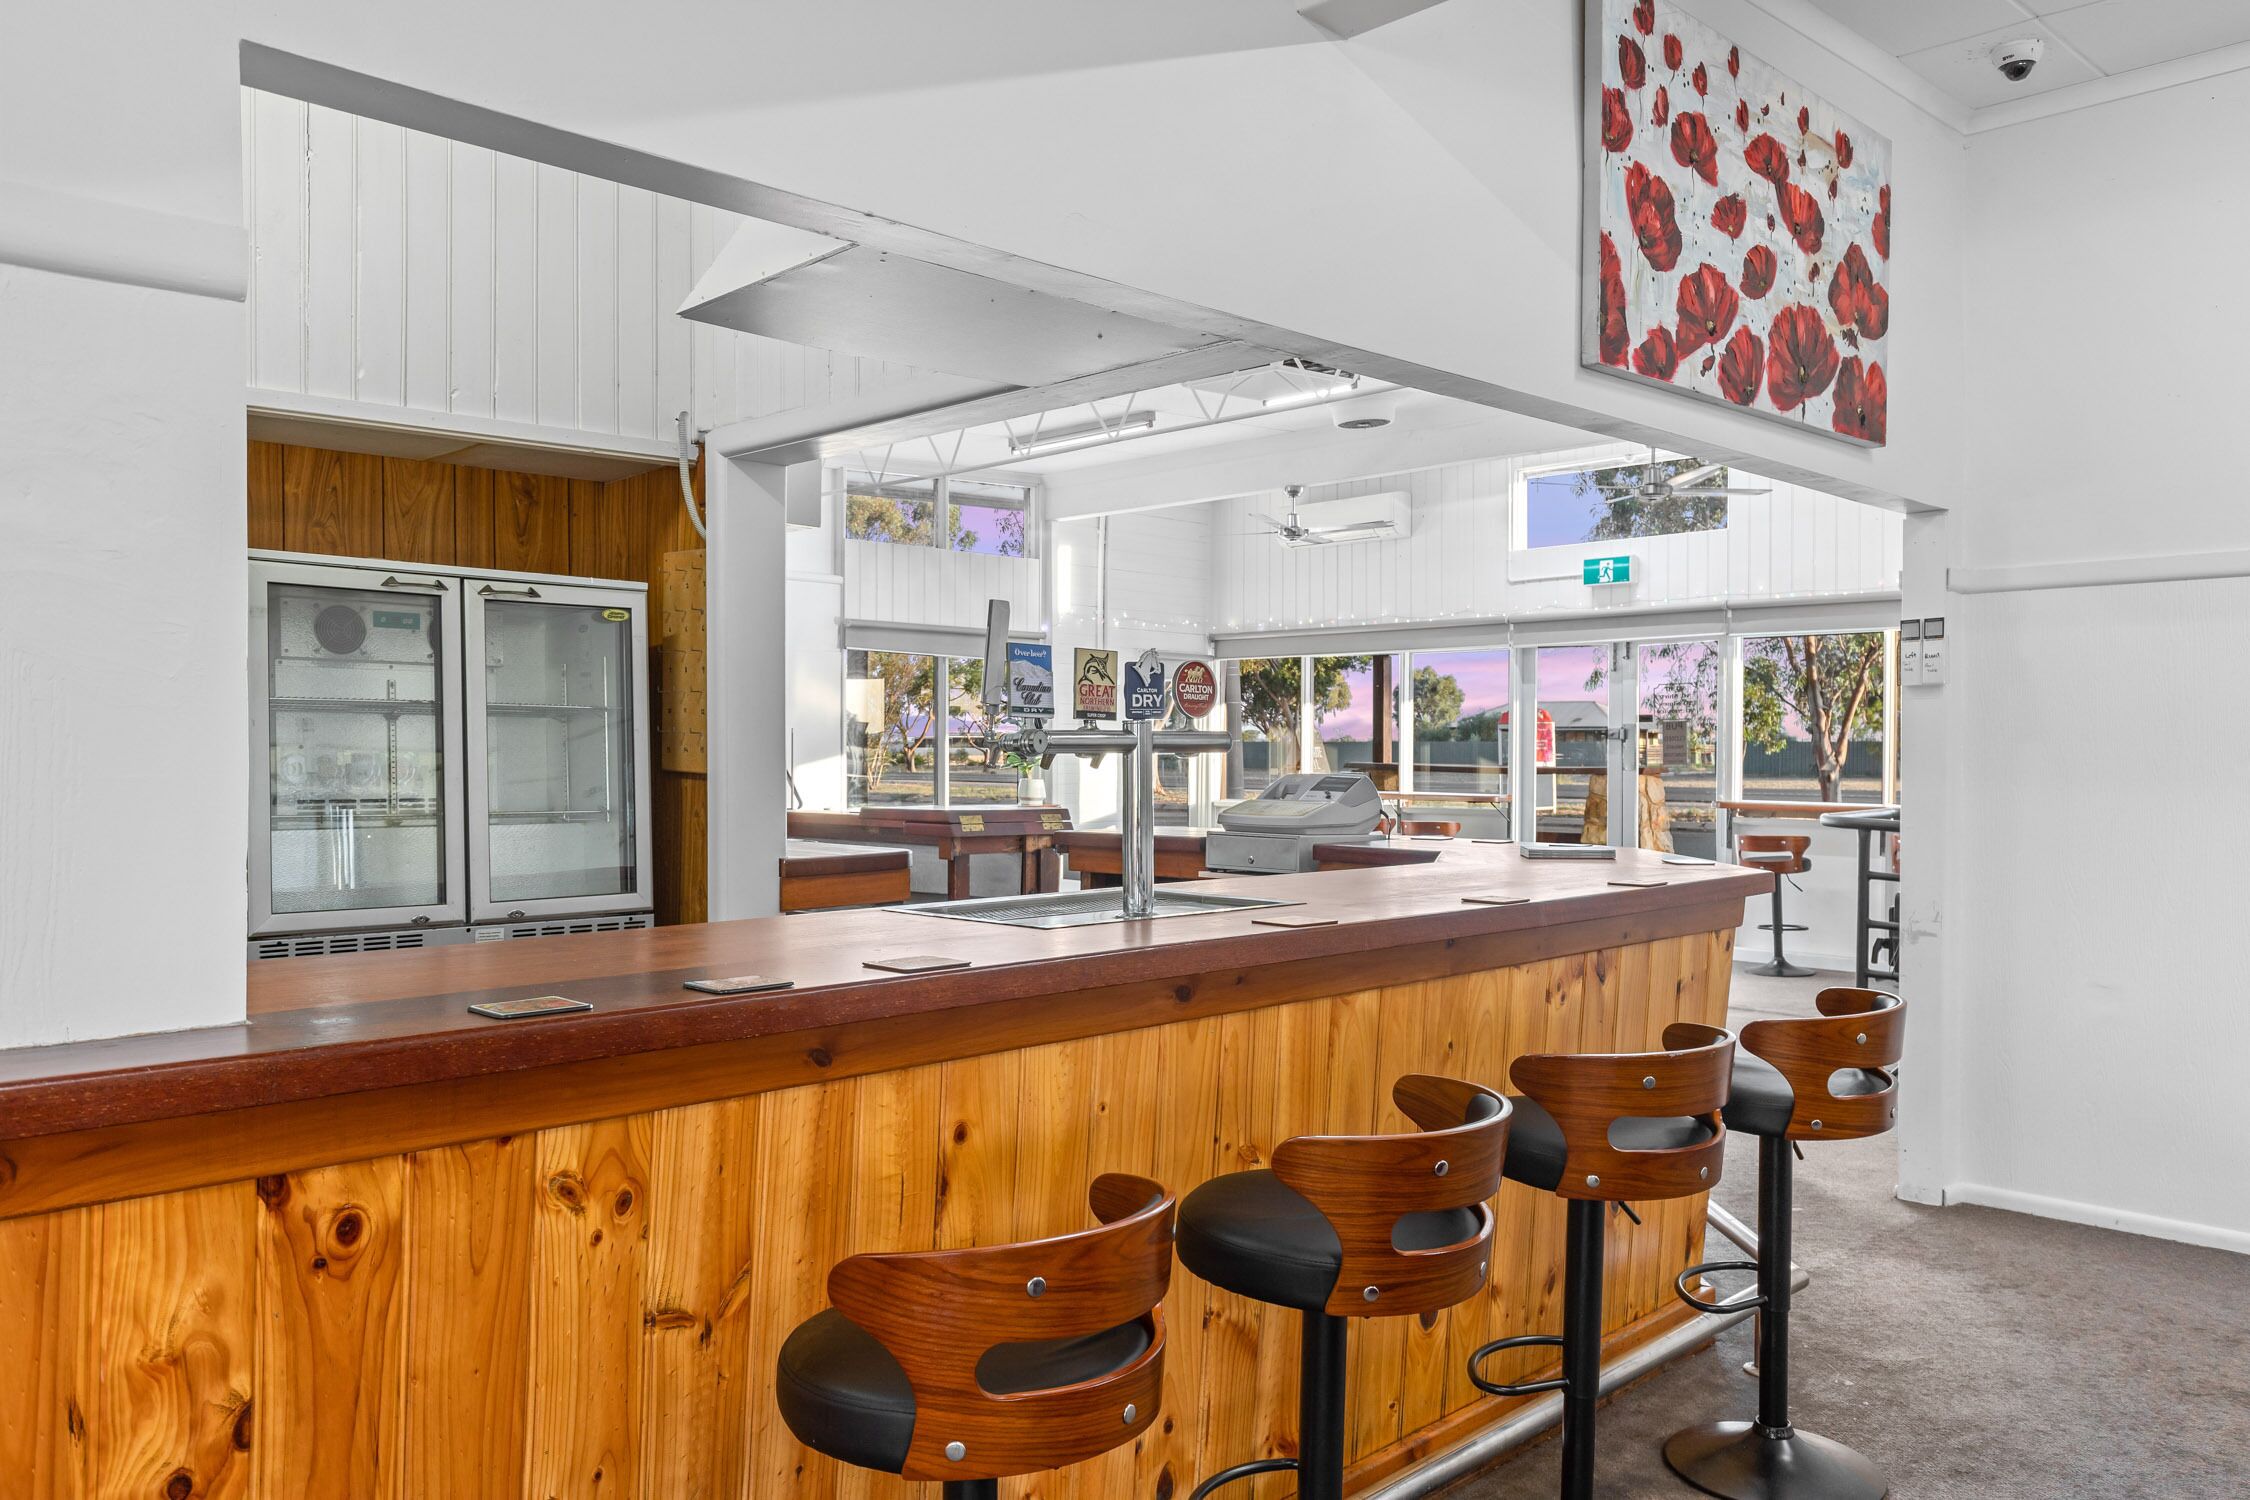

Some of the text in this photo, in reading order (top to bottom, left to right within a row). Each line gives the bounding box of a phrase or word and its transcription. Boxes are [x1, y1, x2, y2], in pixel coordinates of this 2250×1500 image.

[1014, 648, 1047, 658] Over beer?
[1013, 677, 1051, 693] Canadian
[1079, 684, 1116, 698] GREAT
[1179, 683, 1213, 695] CARLTON
[1021, 691, 1042, 705] Club
[1079, 698, 1115, 706] NORTHERN
[1132, 694, 1163, 708] DRY
[1183, 693, 1209, 701] DRAUGHT
